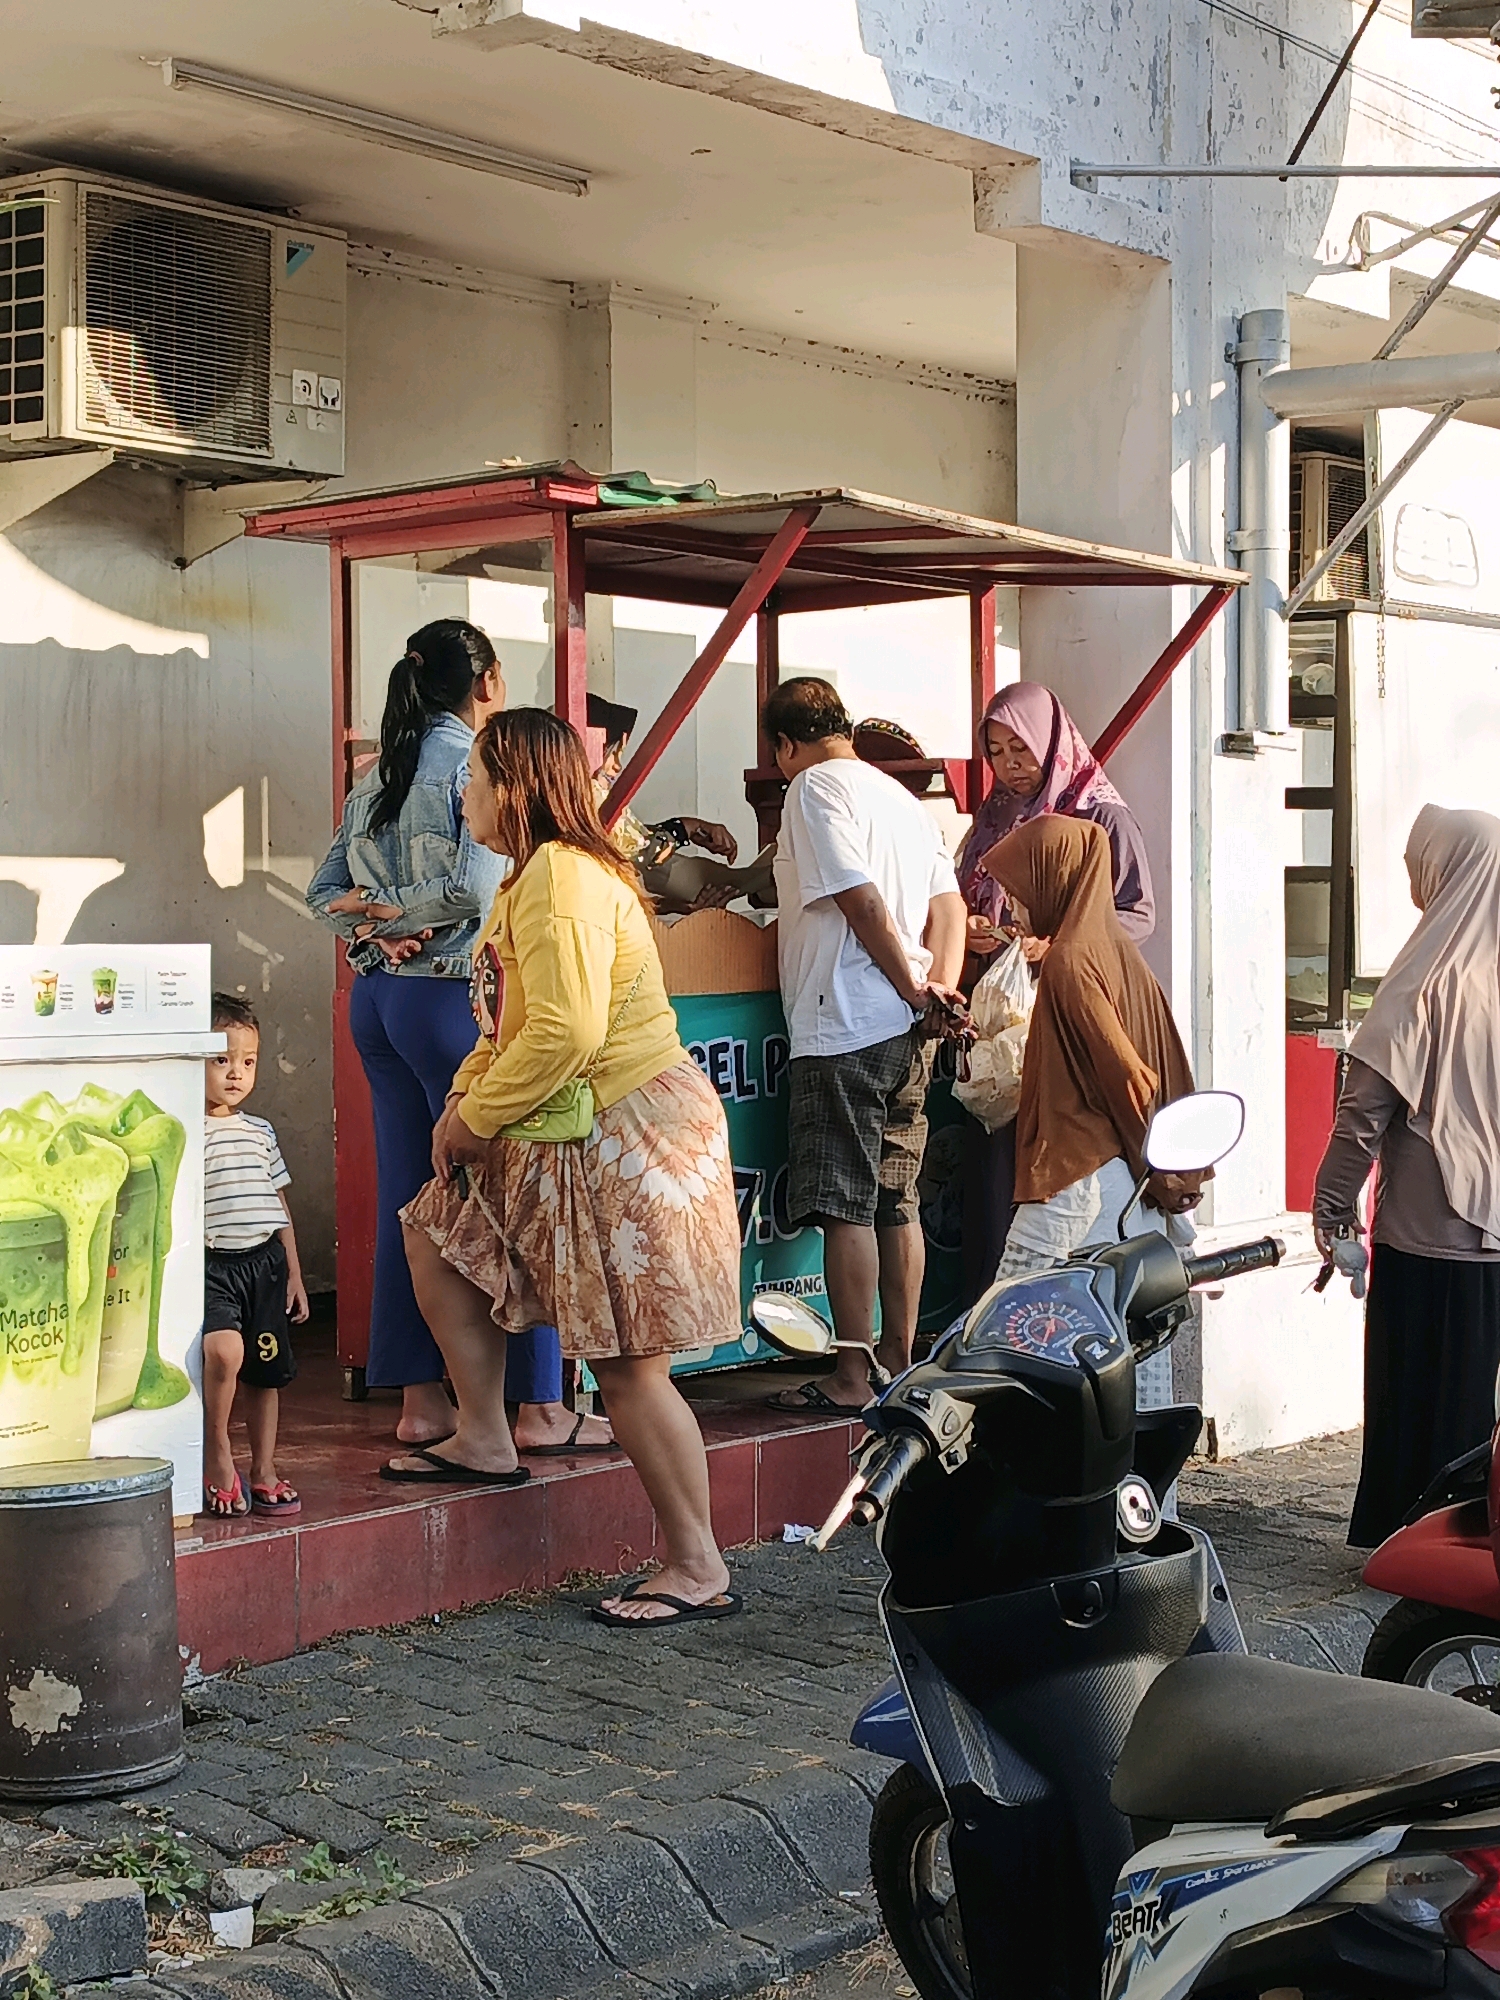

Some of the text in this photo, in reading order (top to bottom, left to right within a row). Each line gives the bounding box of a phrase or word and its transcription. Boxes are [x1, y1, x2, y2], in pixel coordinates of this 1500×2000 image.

[0, 1302, 69, 1332] Matcha
[6, 1326, 64, 1354] Kocok
[257, 1332, 278, 1361] 9
